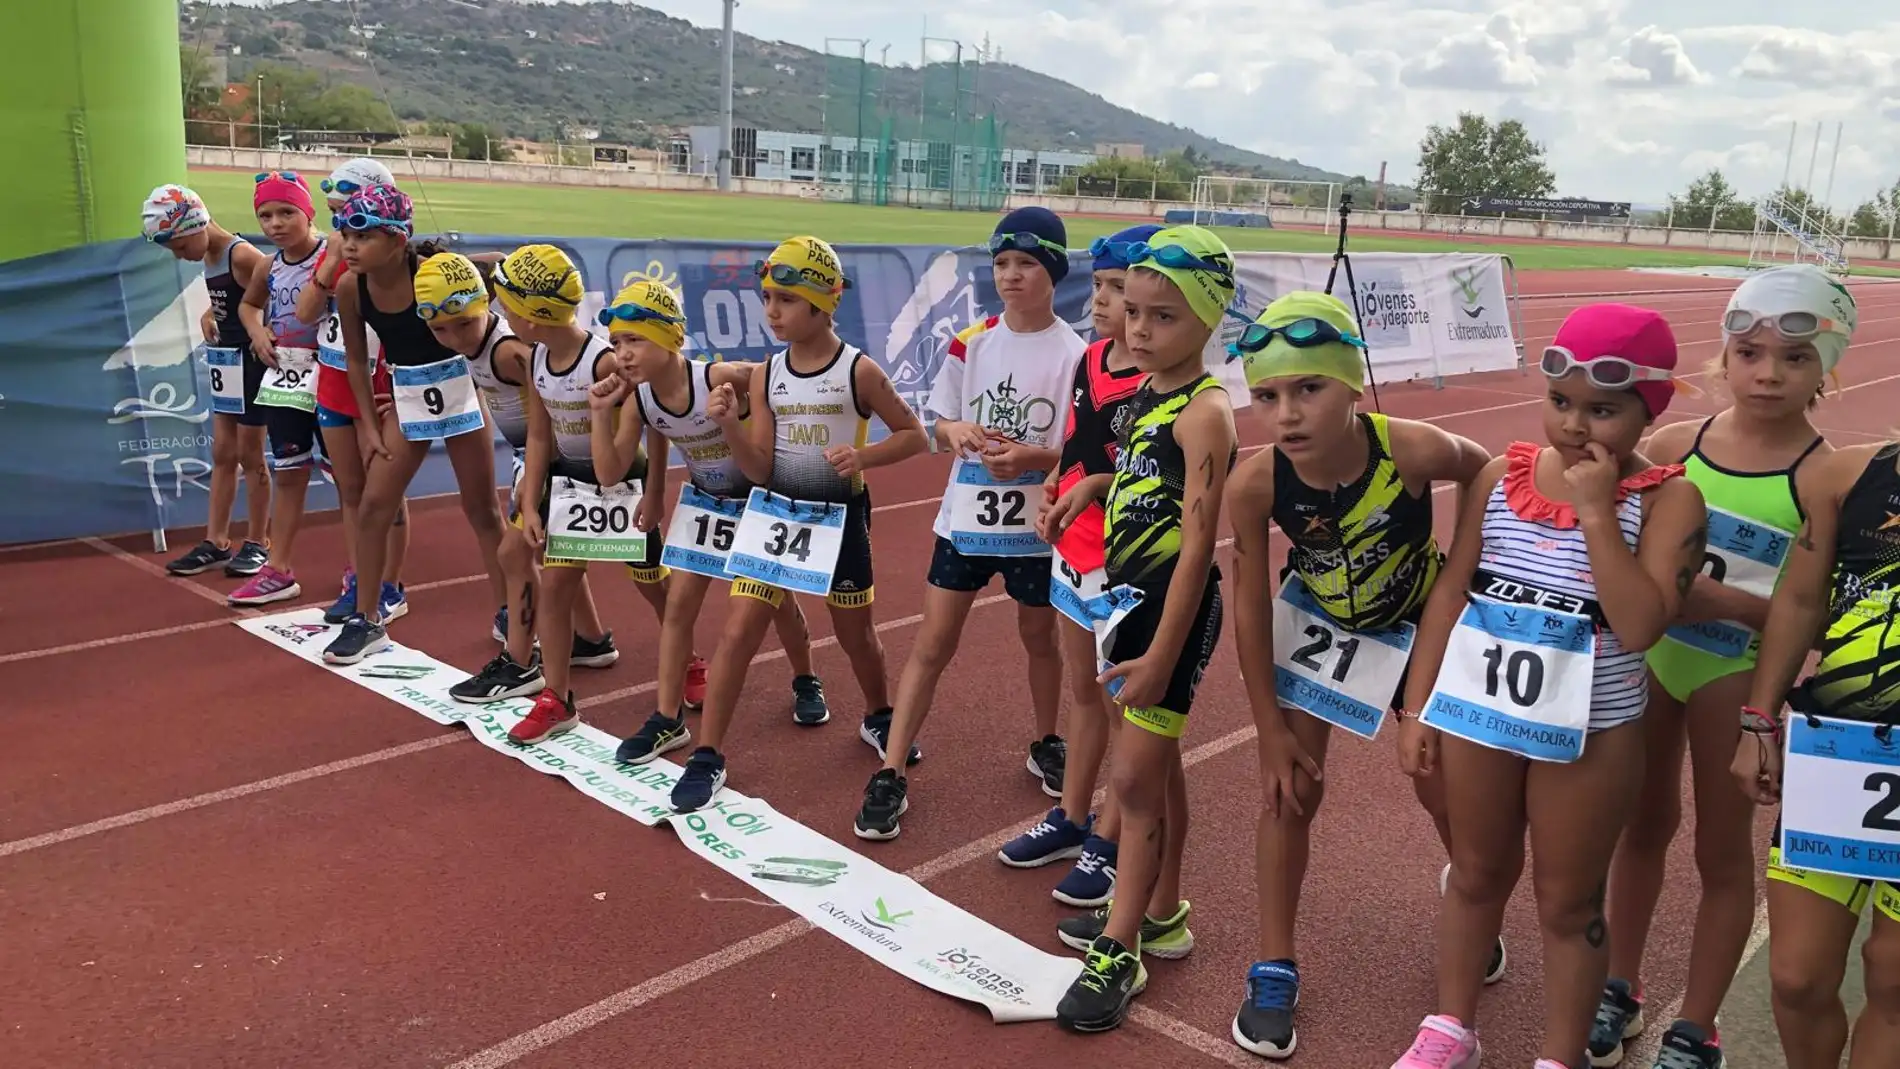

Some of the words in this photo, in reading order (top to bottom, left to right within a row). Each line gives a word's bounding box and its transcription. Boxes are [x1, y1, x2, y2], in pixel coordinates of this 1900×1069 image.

[444, 267, 475, 286] PACE
[511, 259, 552, 293] PACENS
[1361, 282, 1416, 317] jóvenes
[1447, 322, 1508, 341] Extremadura
[424, 387, 444, 415] 9
[787, 423, 830, 446] DAVID
[566, 503, 629, 534] 290
[976, 489, 1026, 527] 32
[589, 543, 641, 553] EXTREMADURA
[694, 513, 736, 552] 15
[763, 522, 813, 563] 34
[1290, 624, 1361, 684] 21
[1482, 643, 1545, 708] 10
[1299, 685, 1376, 726] EXTREMADURA
[1431, 698, 1464, 720] JUNTA
[1468, 709, 1484, 726] DE
[1486, 716, 1576, 749] EXTREMADURA
[393, 685, 470, 721] TRIATLÓ
[574, 769, 647, 807] JUDEX
[1789, 836, 1832, 857] JUNTA
[1842, 845, 1859, 860] DE
[818, 900, 903, 953] Extremadura
